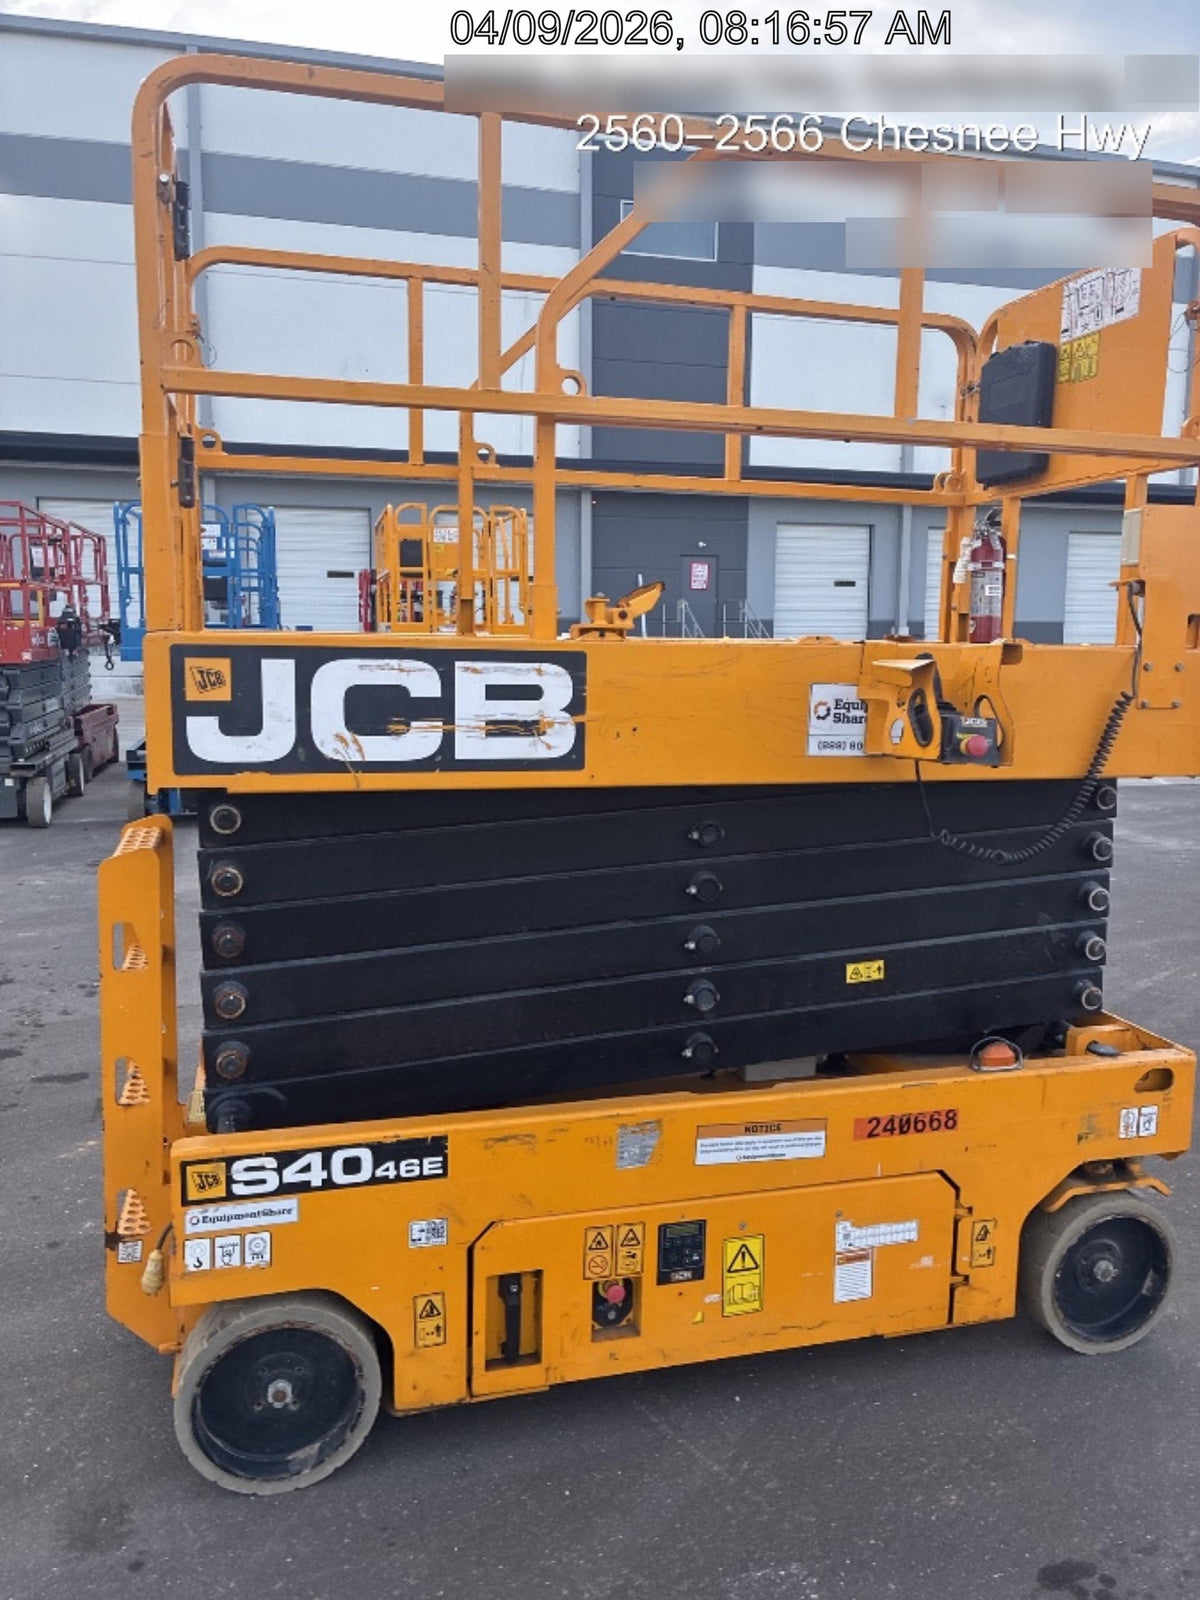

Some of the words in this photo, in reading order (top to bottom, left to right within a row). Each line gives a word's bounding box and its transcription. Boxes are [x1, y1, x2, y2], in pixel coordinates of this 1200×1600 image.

[195, 666, 226, 691] JCB
[186, 658, 577, 763] JCB
[744, 1123, 783, 1134] NOTICE
[202, 1207, 293, 1224] EquipmentShare
